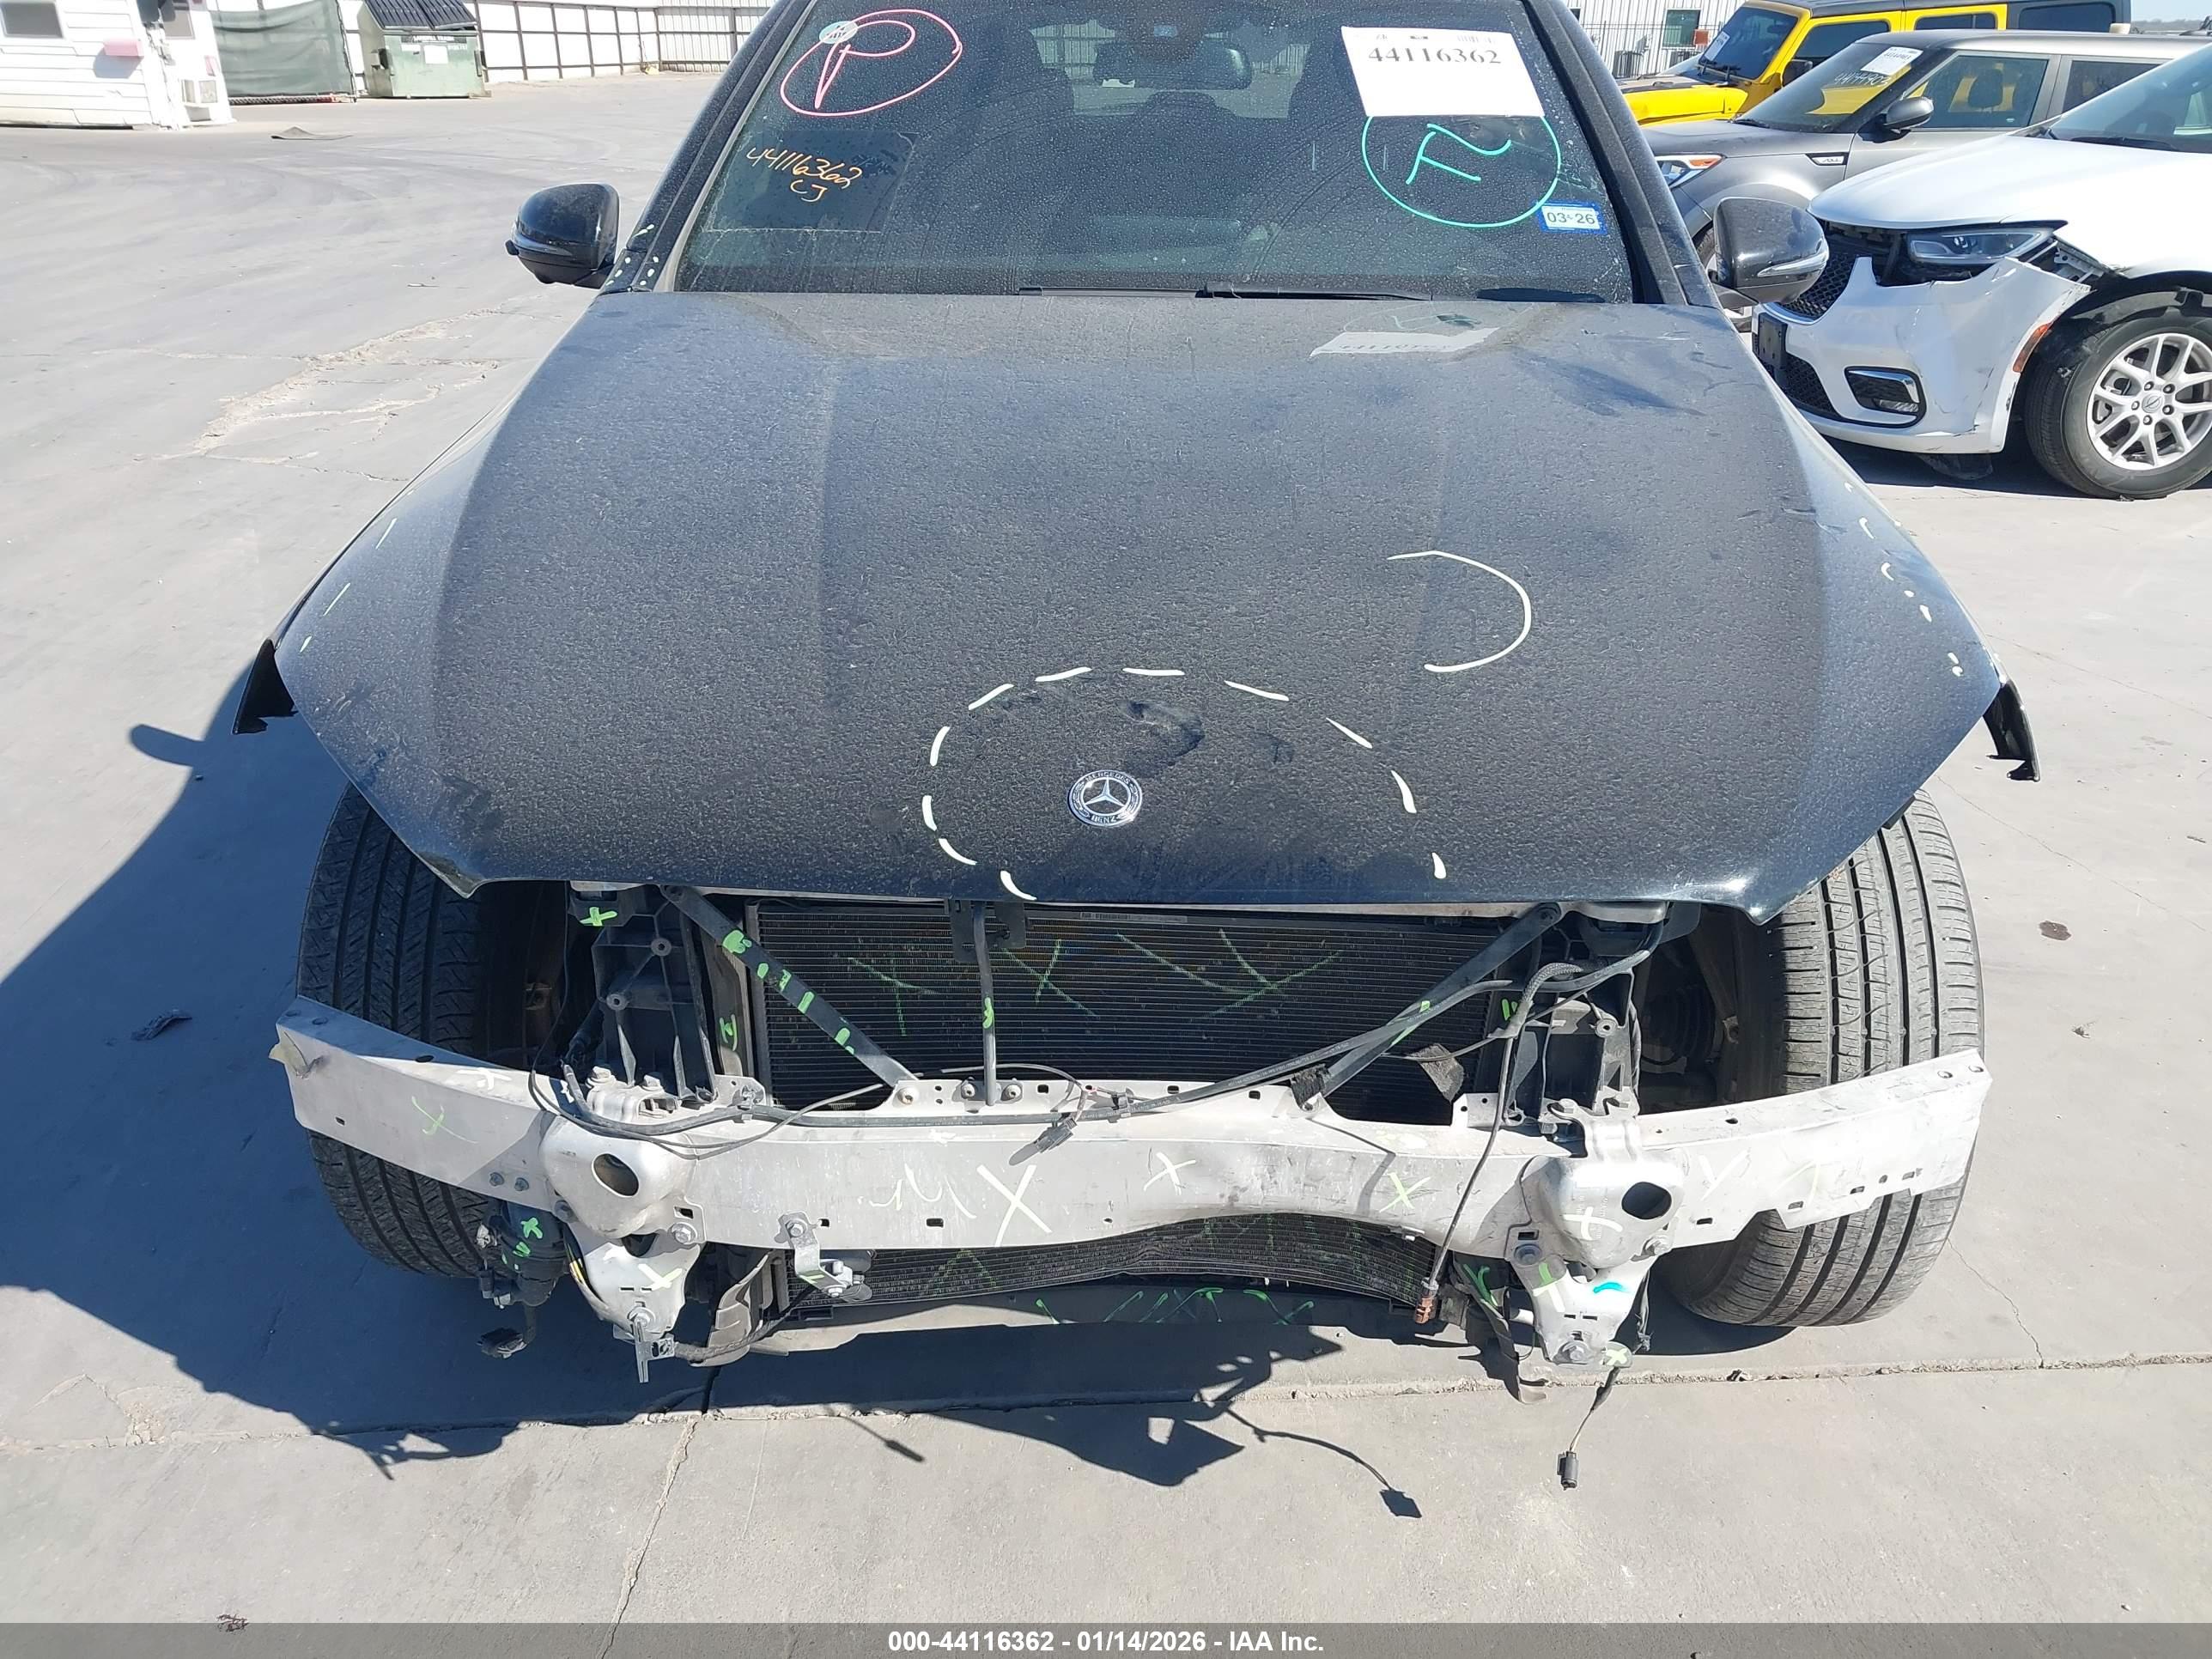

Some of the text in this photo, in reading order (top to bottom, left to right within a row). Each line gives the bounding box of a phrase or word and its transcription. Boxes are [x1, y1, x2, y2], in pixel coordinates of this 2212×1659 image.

[1368, 46, 1502, 64] 44116362
[746, 147, 863, 190] 44116362
[1575, 213, 1595, 224] 26
[1085, 771, 1131, 785] MERCEDES
[1091, 815, 1117, 824] BENZ
